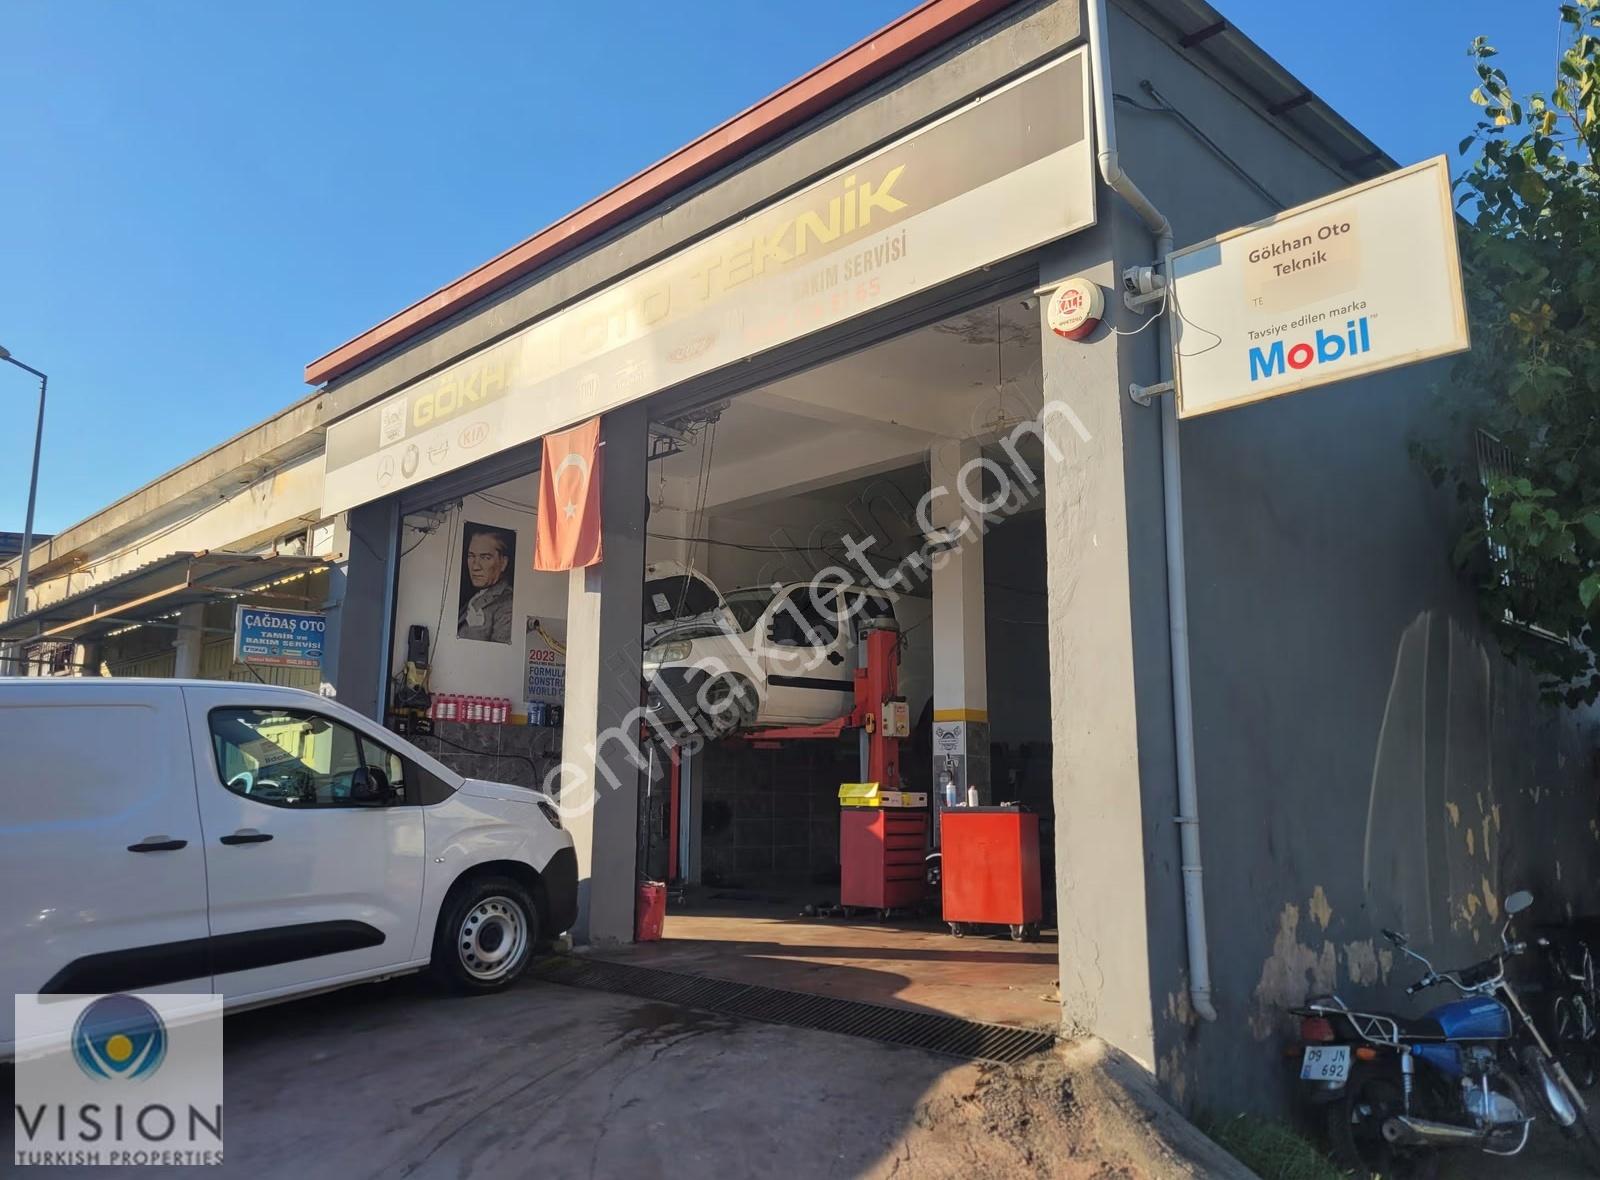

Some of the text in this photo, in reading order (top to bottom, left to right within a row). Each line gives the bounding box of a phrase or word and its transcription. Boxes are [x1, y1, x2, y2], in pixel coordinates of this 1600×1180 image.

[691, 163, 909, 300] TEKNİK
[1248, 222, 1351, 264] Gökhan Oto
[843, 229, 907, 281] SERVİSİ
[1273, 250, 1327, 277] Teknik
[1248, 300, 1367, 341] Tavsiye edilen marka
[1248, 317, 1370, 382] Mobil
[244, 613, 326, 633] ÇAĞDAŞ OTO
[245, 637, 280, 646] BAKIM
[529, 649, 555, 662] 2023
[528, 686, 557, 697] WORLD
[1308, 1050, 1322, 1062] 09
[1321, 1065, 1344, 1078] 692
